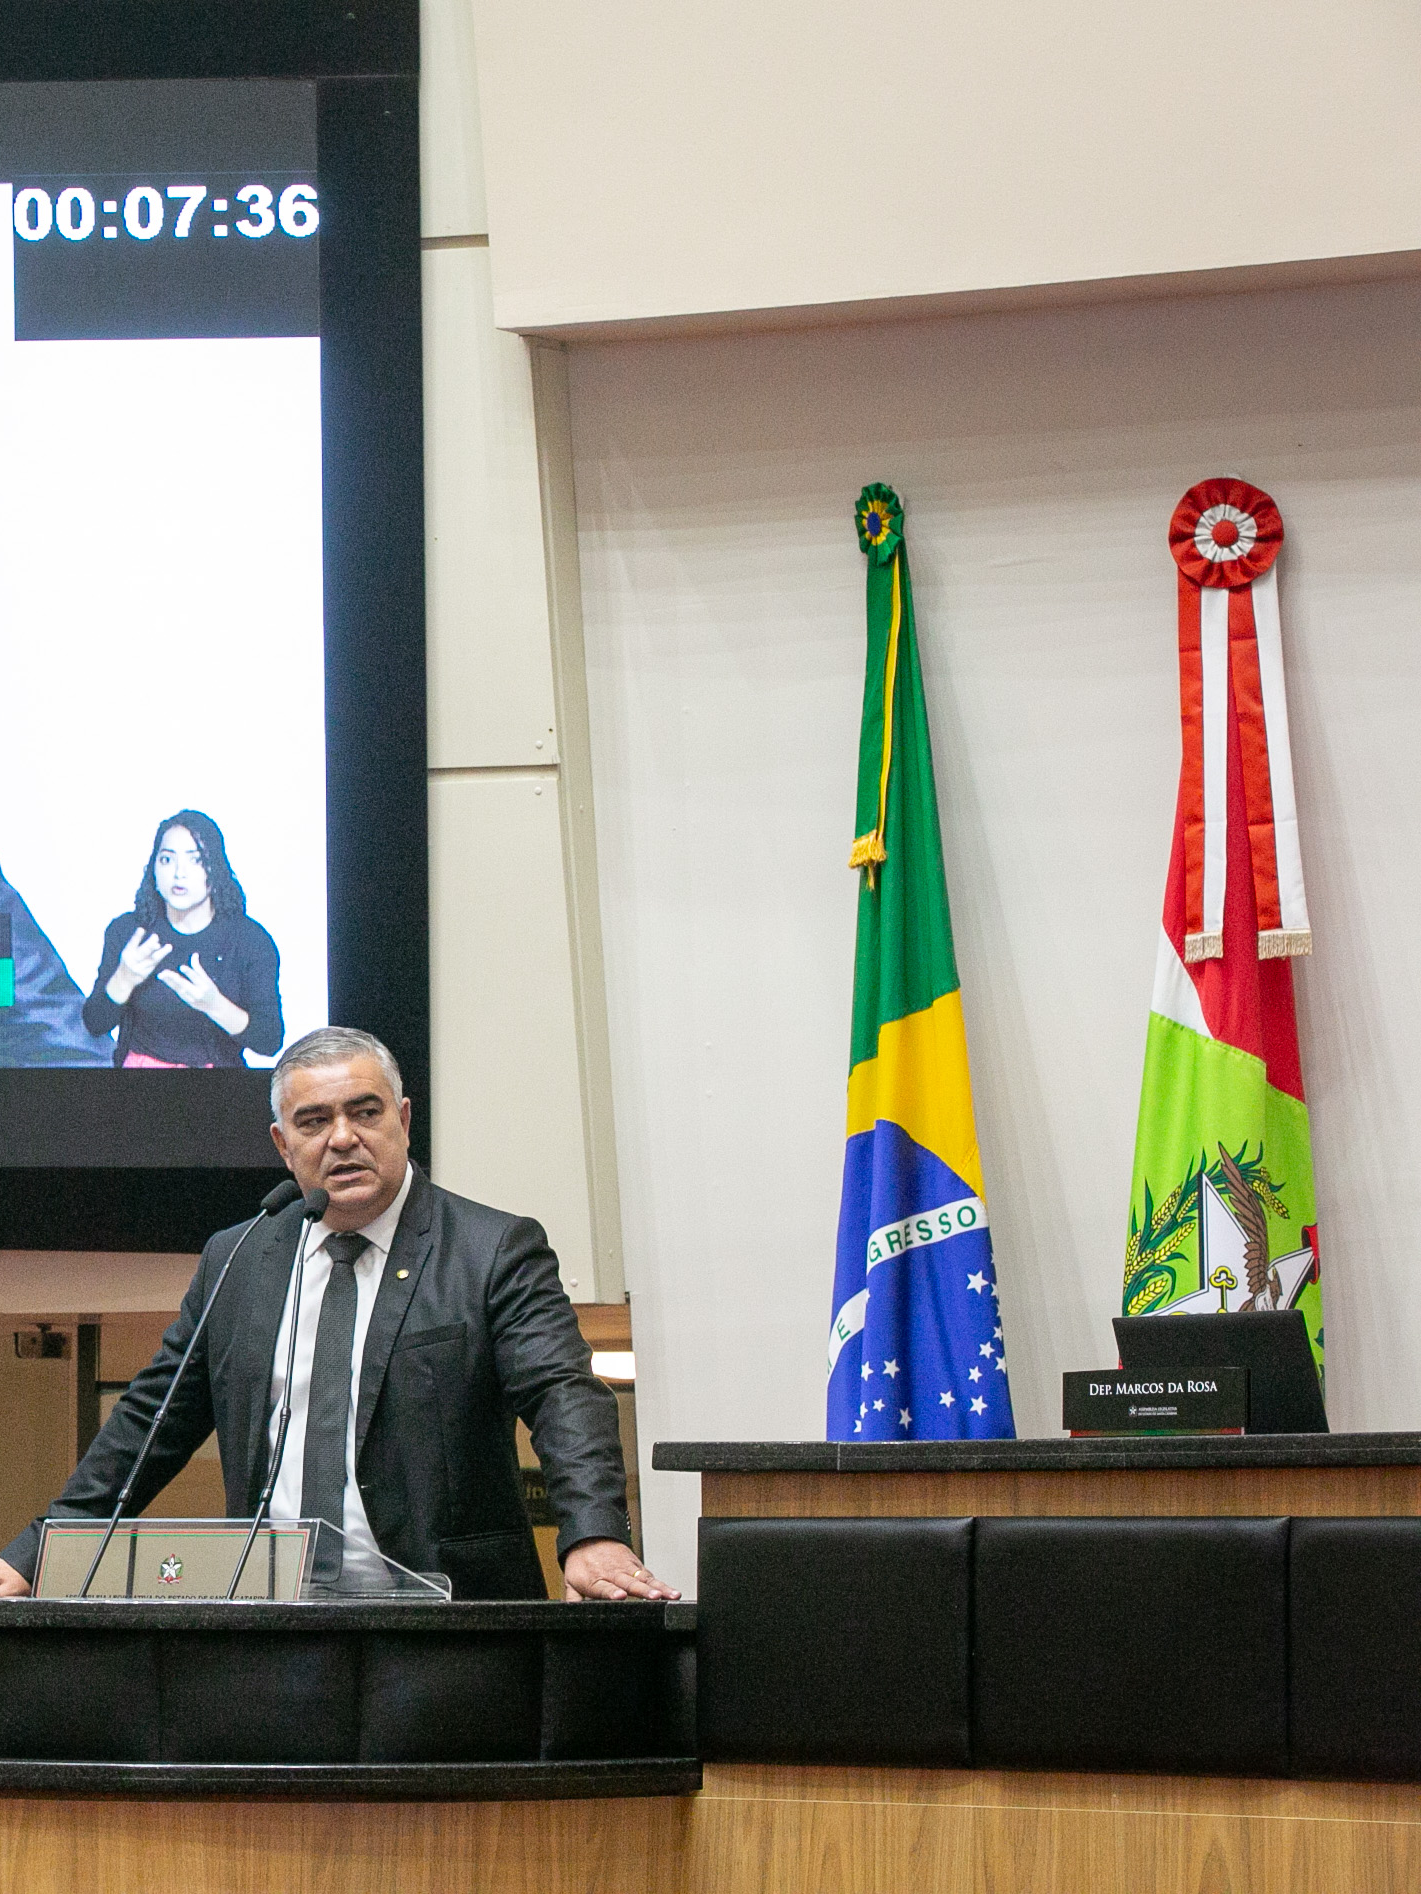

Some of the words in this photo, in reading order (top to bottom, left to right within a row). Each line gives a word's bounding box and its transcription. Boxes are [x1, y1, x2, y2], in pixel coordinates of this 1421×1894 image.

[13, 184, 320, 242] 00:07:36
[868, 1205, 977, 1263] GRESSO
[1116, 1382, 1164, 1395] MARCOS
[1187, 1380, 1218, 1393] ROSA
